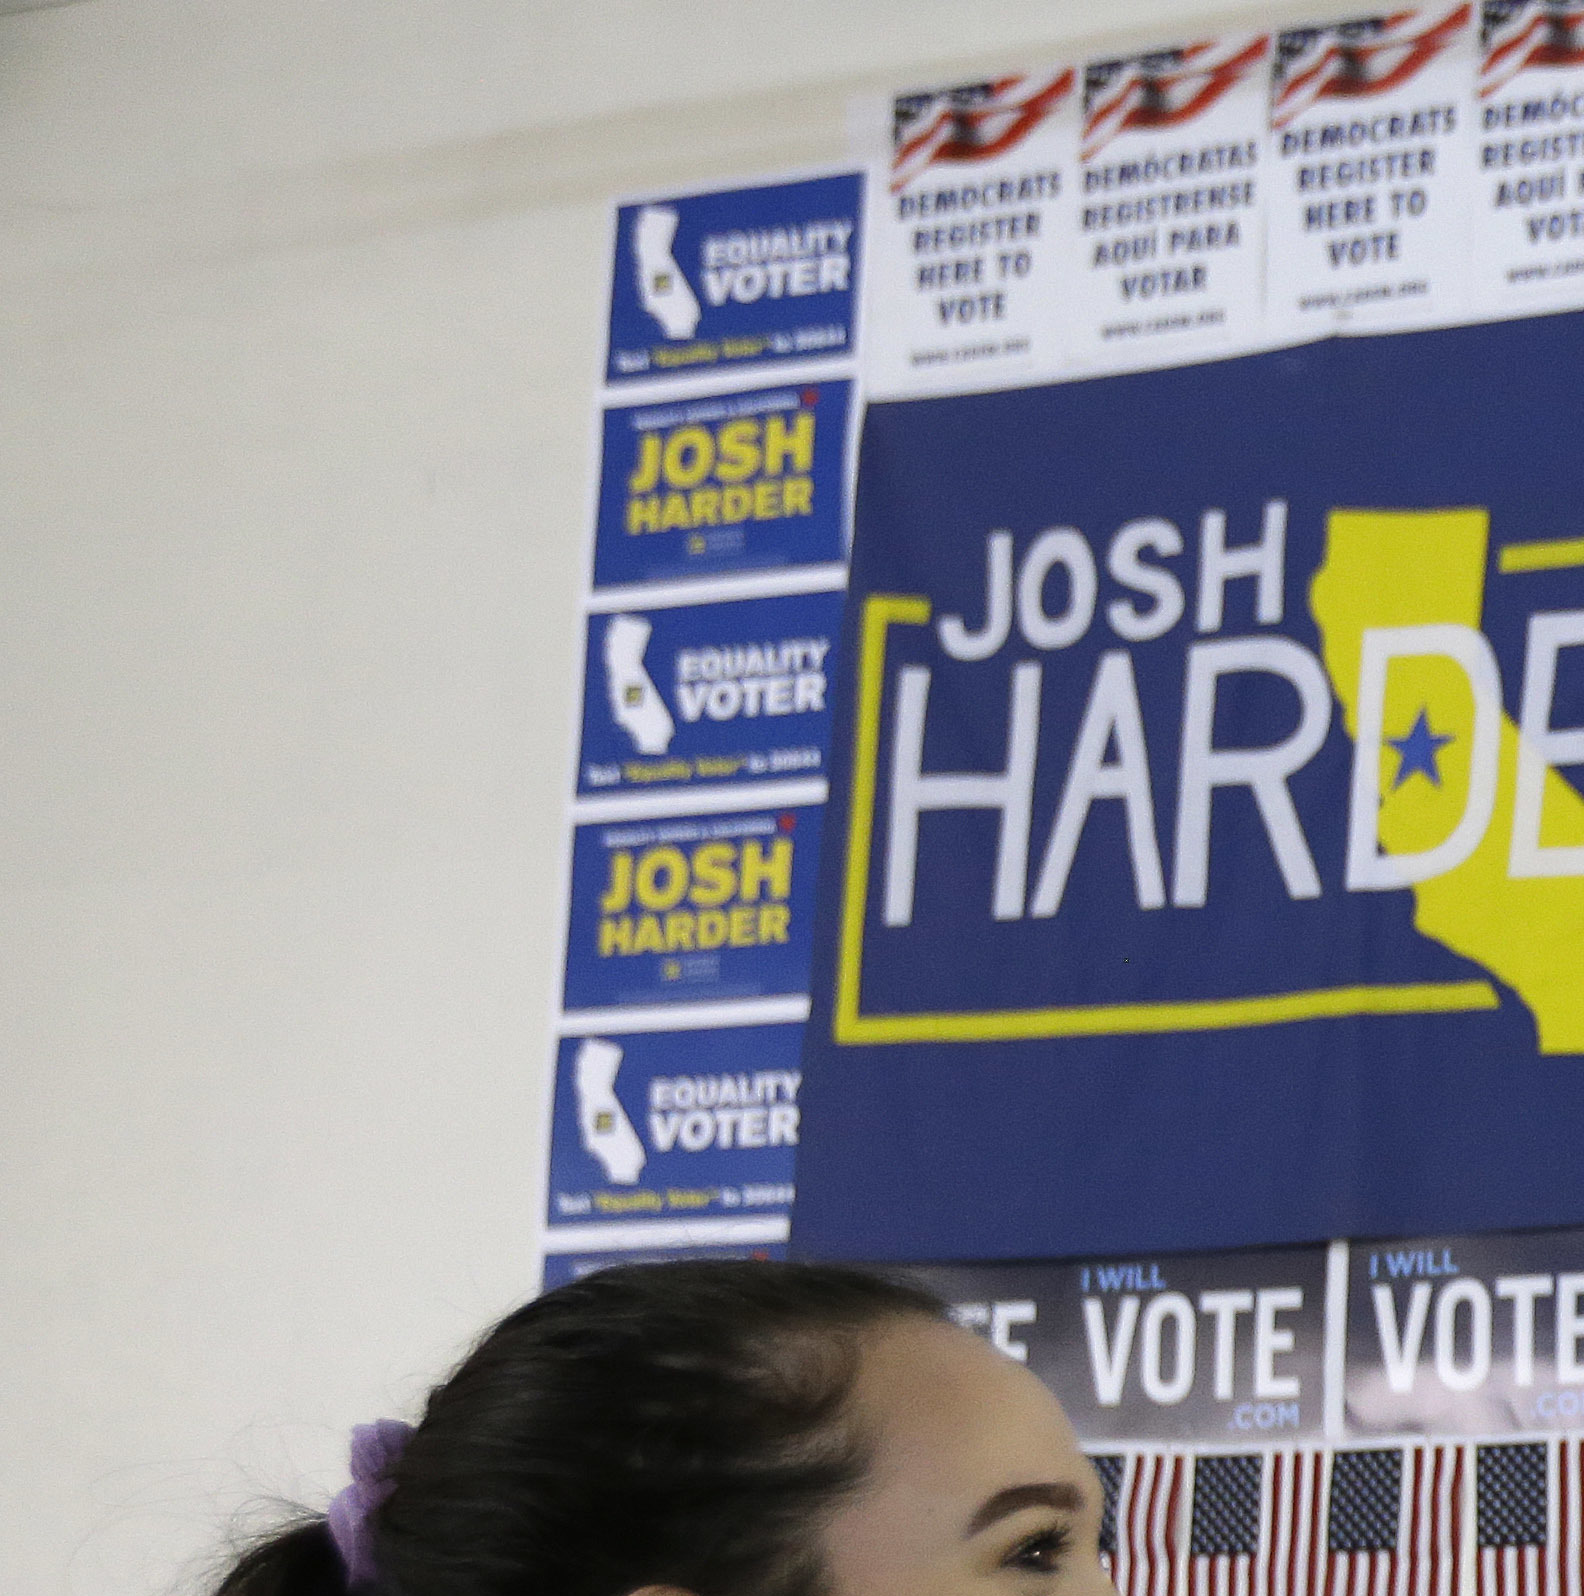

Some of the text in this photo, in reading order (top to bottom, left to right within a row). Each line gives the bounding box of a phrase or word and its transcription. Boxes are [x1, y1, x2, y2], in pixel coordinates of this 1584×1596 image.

[1280, 104, 1457, 157] DEMOCRATS
[1299, 146, 1435, 193] REGISTER
[1495, 169, 1566, 208] AQUÍ
[898, 171, 1062, 220] DEMOCRATS
[1305, 189, 1428, 232] HERE TO
[704, 218, 852, 267] EQUALITY
[913, 212, 1041, 255] REGISTER
[1170, 221, 1239, 257] PARA
[1328, 233, 1399, 268] VOTE
[704, 253, 850, 306] VOTER
[916, 251, 1031, 291] HERE TO
[1120, 266, 1207, 301] VOTAR
[937, 294, 1006, 326] VOTE
[630, 412, 815, 492] JOSH
[626, 476, 813, 535] HARDER
[939, 497, 1287, 661] JOSH
[677, 638, 830, 679] EQUALITY
[677, 672, 826, 722] VOTER
[601, 838, 793, 912] JOSH
[600, 905, 789, 958] HARDER
[650, 1071, 801, 1108] EQUALITY
[650, 1105, 800, 1152] VOTER
[1081, 1263, 1167, 1292] I WILL
[1370, 1249, 1460, 1279] I WILL
[1083, 1285, 1304, 1408] VOTE
[1228, 1401, 1300, 1429] .COM
